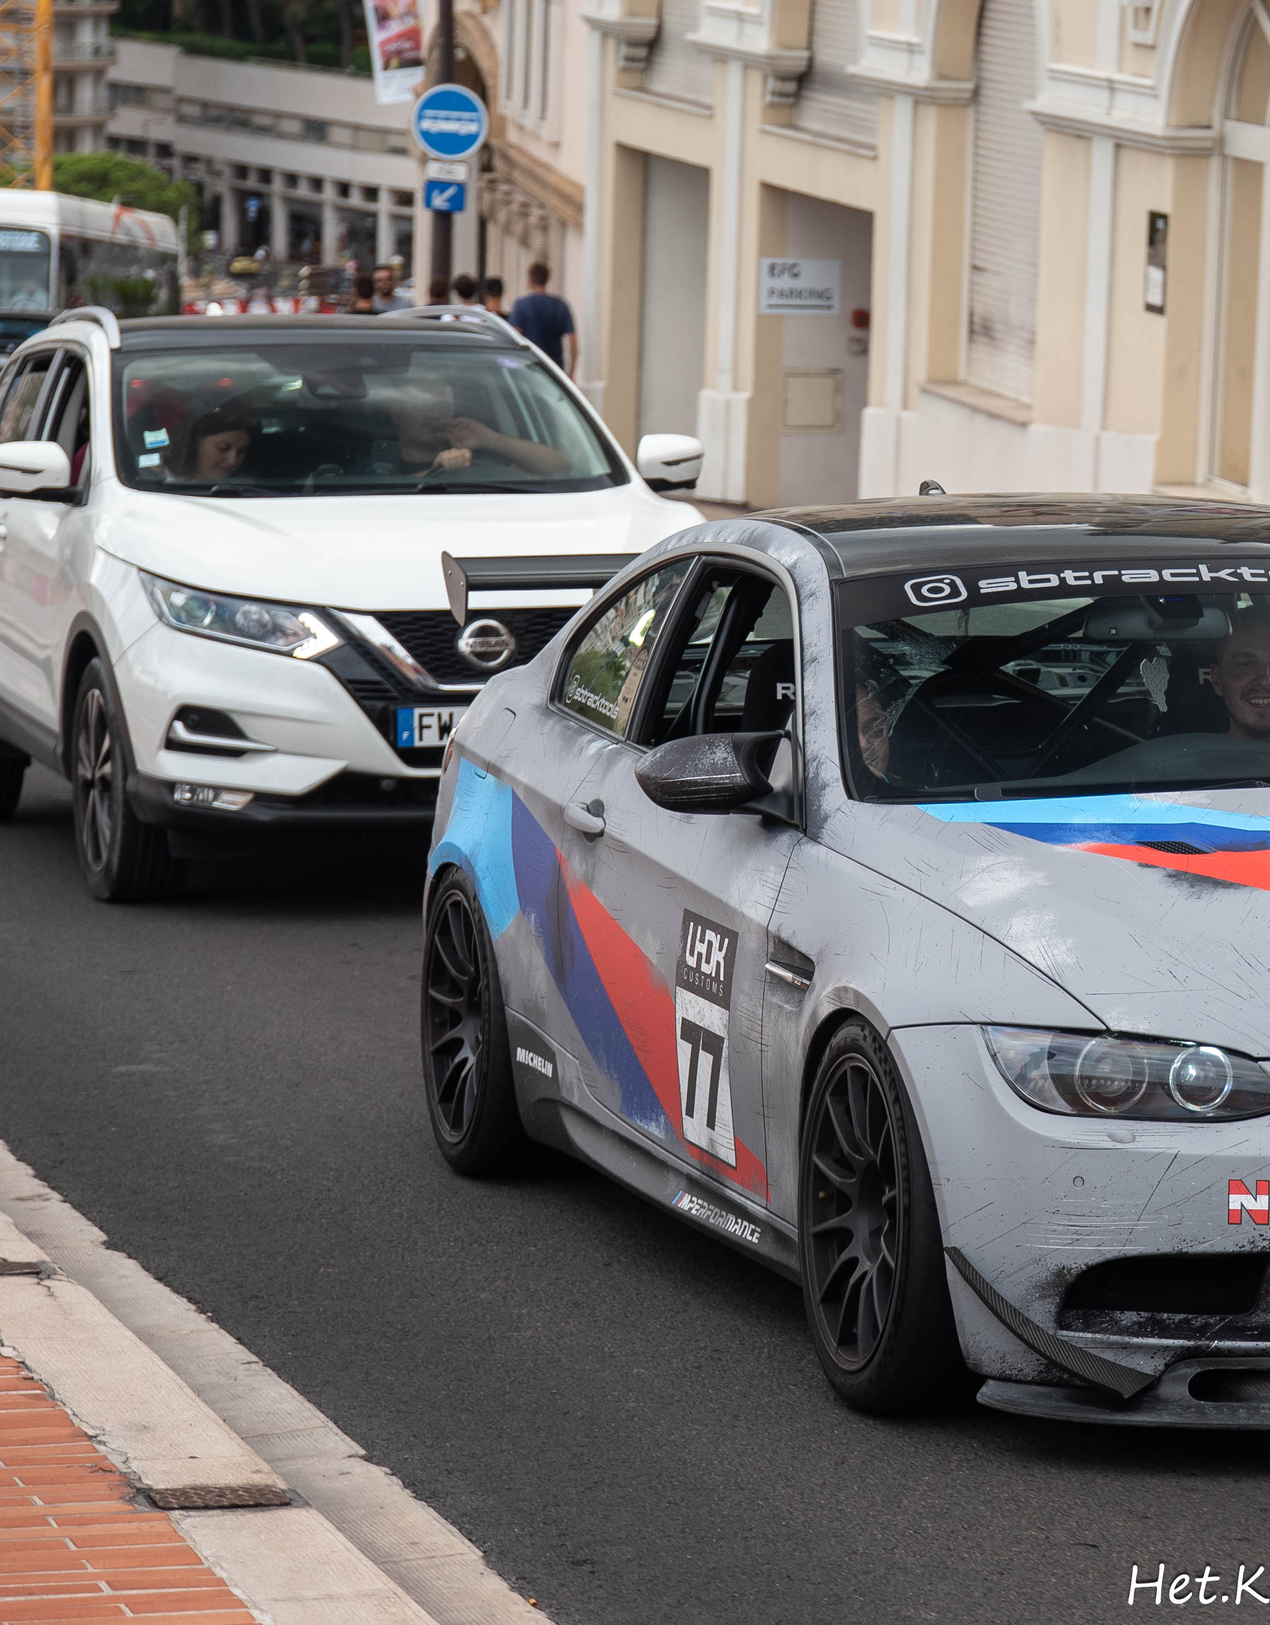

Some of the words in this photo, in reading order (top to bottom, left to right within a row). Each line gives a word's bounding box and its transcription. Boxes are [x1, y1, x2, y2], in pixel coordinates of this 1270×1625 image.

[767, 286, 835, 301] PARKING
[465, 640, 510, 650] NISSAN
[573, 684, 621, 720] sbtracktools
[683, 967, 724, 997] CUSTOMS
[516, 1046, 553, 1078] MICHELIN
[680, 1016, 725, 1131] 77
